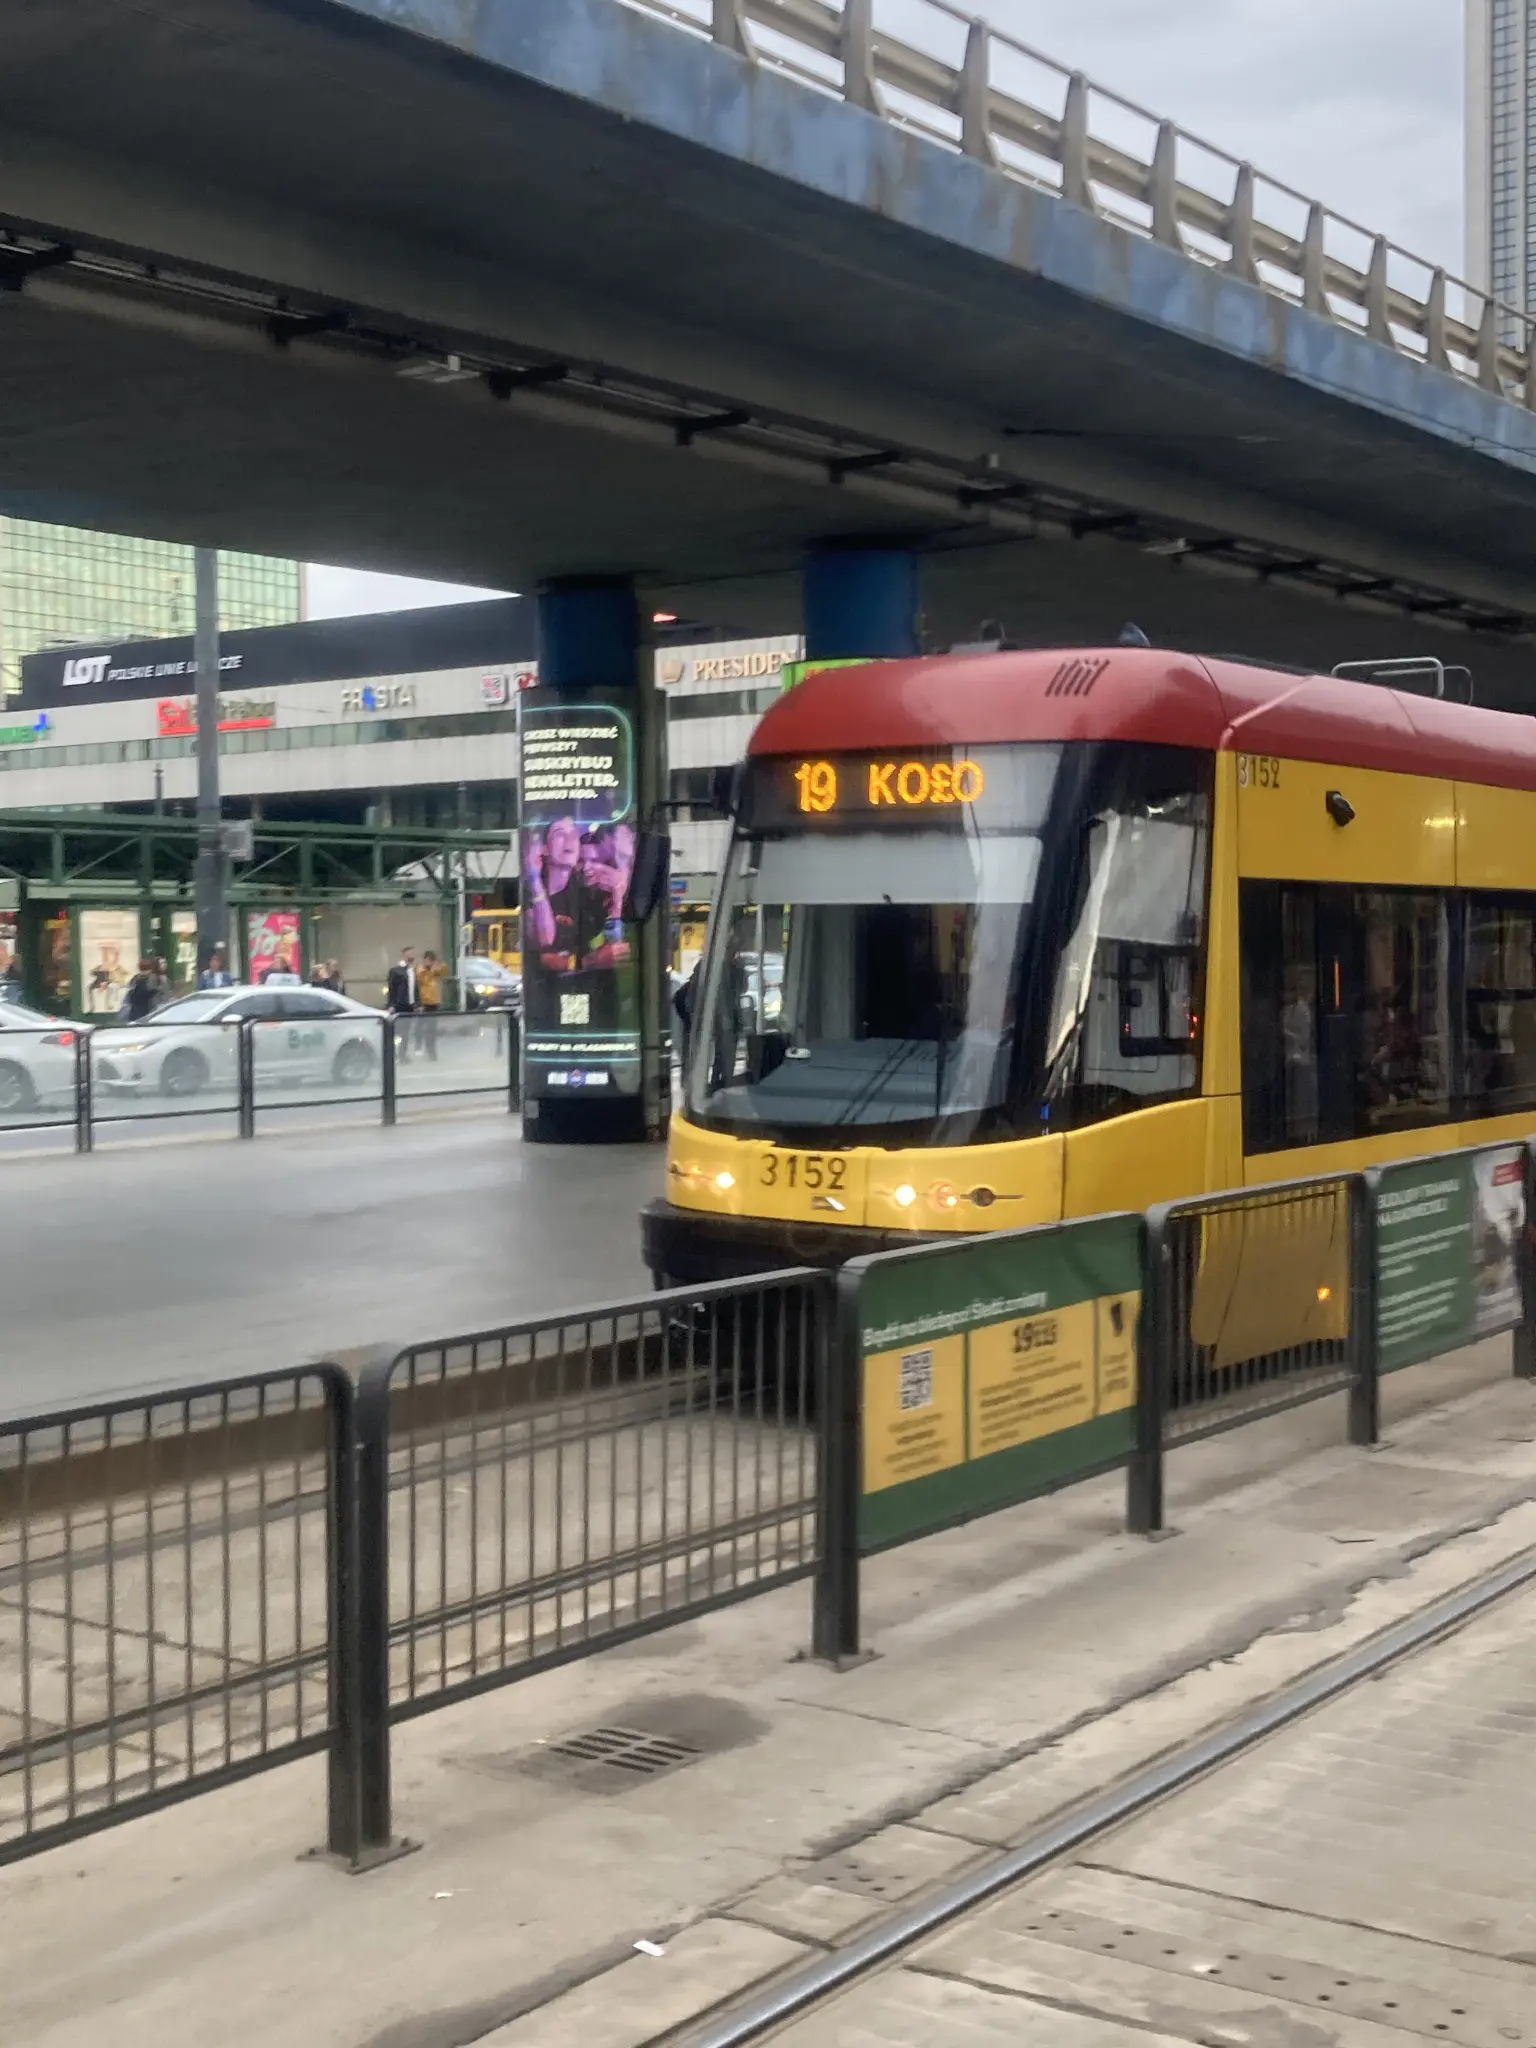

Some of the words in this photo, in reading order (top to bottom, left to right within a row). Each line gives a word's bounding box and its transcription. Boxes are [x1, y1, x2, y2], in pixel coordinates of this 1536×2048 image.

[63, 655, 111, 686] LOT
[794, 761, 837, 812] 19
[1237, 754, 1281, 789] 3152
[759, 1153, 847, 1191] 3152
